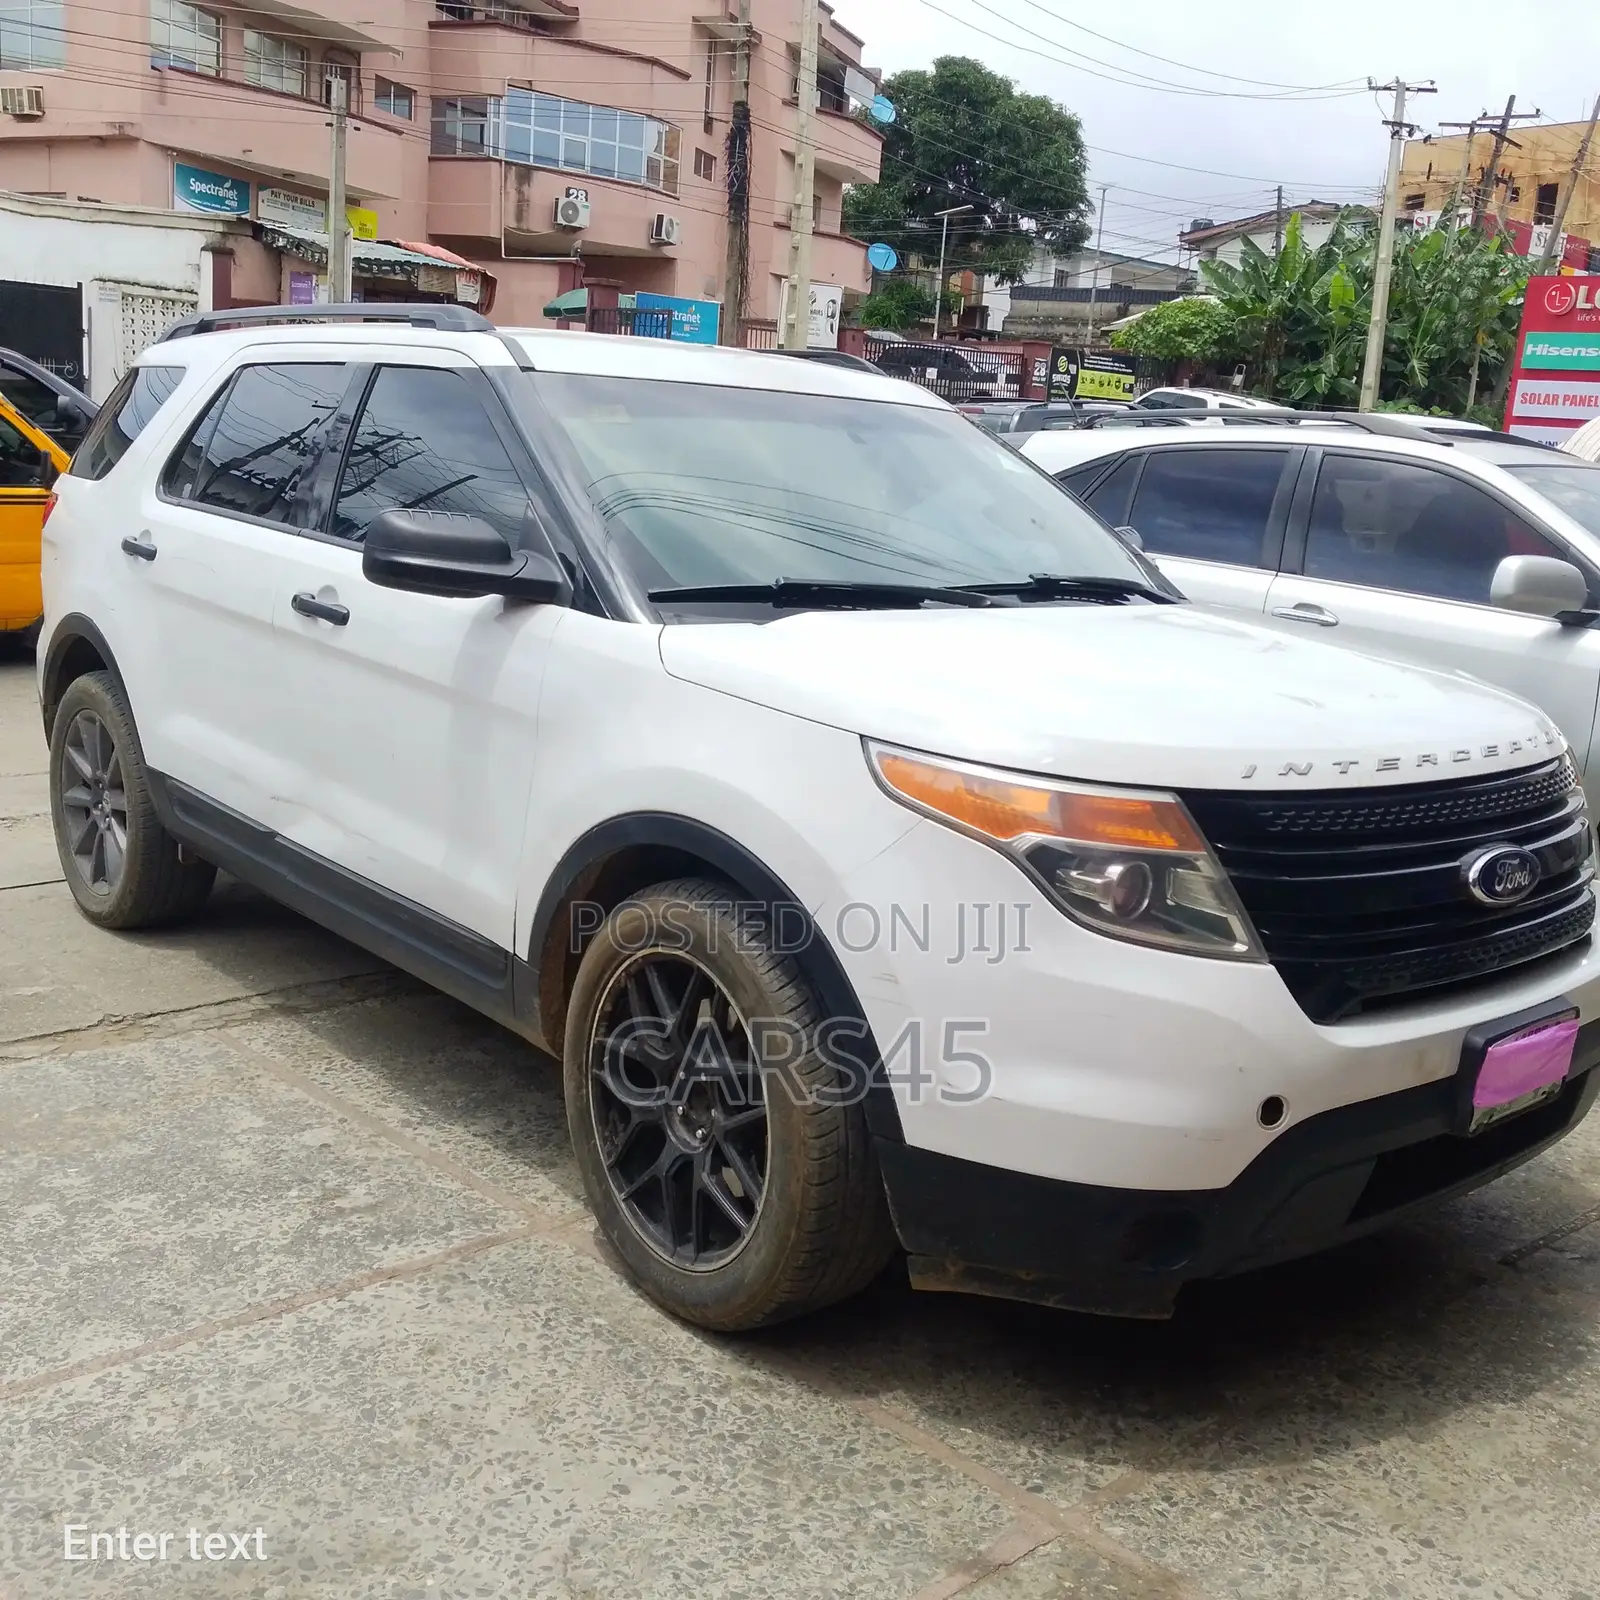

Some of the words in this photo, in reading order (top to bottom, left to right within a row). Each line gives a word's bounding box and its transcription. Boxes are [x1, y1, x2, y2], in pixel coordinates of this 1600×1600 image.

[189, 177, 238, 201] Spectranet
[568, 188, 586, 201] 28
[270, 190, 281, 199] PAY
[283, 193, 299, 205] YOUR
[299, 197, 315, 208] BILLS
[1526, 343, 1600, 357] Hisens
[1034, 362, 1046, 376] 28
[1520, 391, 1560, 407] SOLAR
[1494, 858, 1532, 893] Ford
